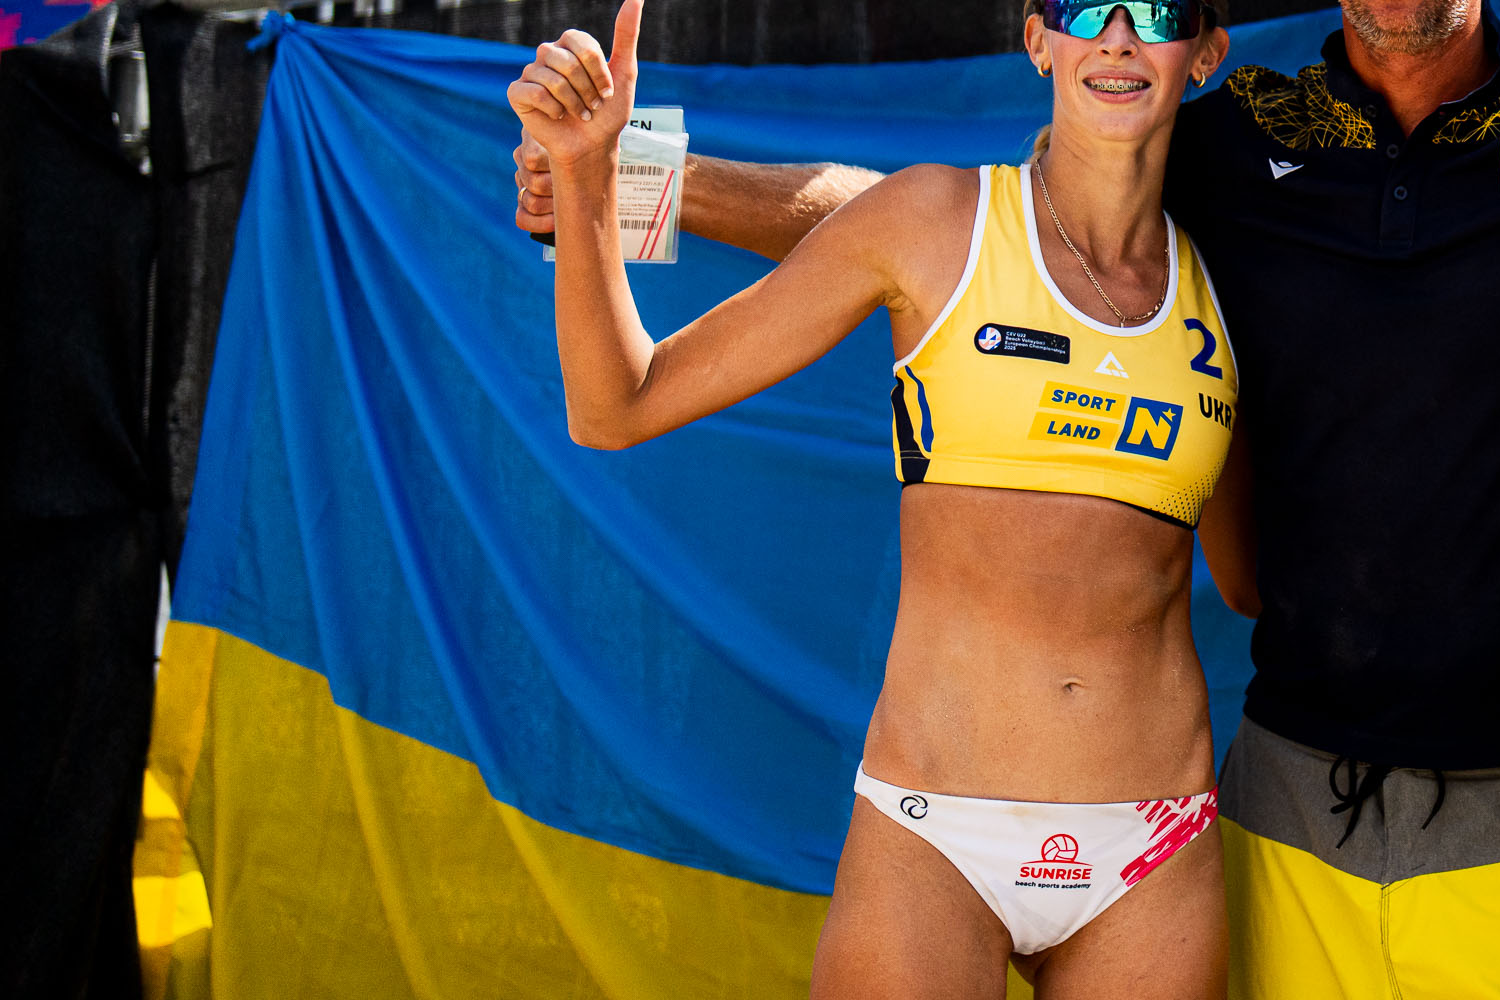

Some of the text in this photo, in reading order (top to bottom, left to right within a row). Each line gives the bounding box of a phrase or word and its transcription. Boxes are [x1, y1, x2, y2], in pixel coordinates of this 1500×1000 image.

[1184, 317, 1223, 380] 2
[1051, 388, 1117, 412] SPORT
[1198, 392, 1233, 432] UKR
[1047, 420, 1101, 441] LAND
[1015, 880, 1036, 888] beach
[1019, 866, 1093, 880] SUNRISE
